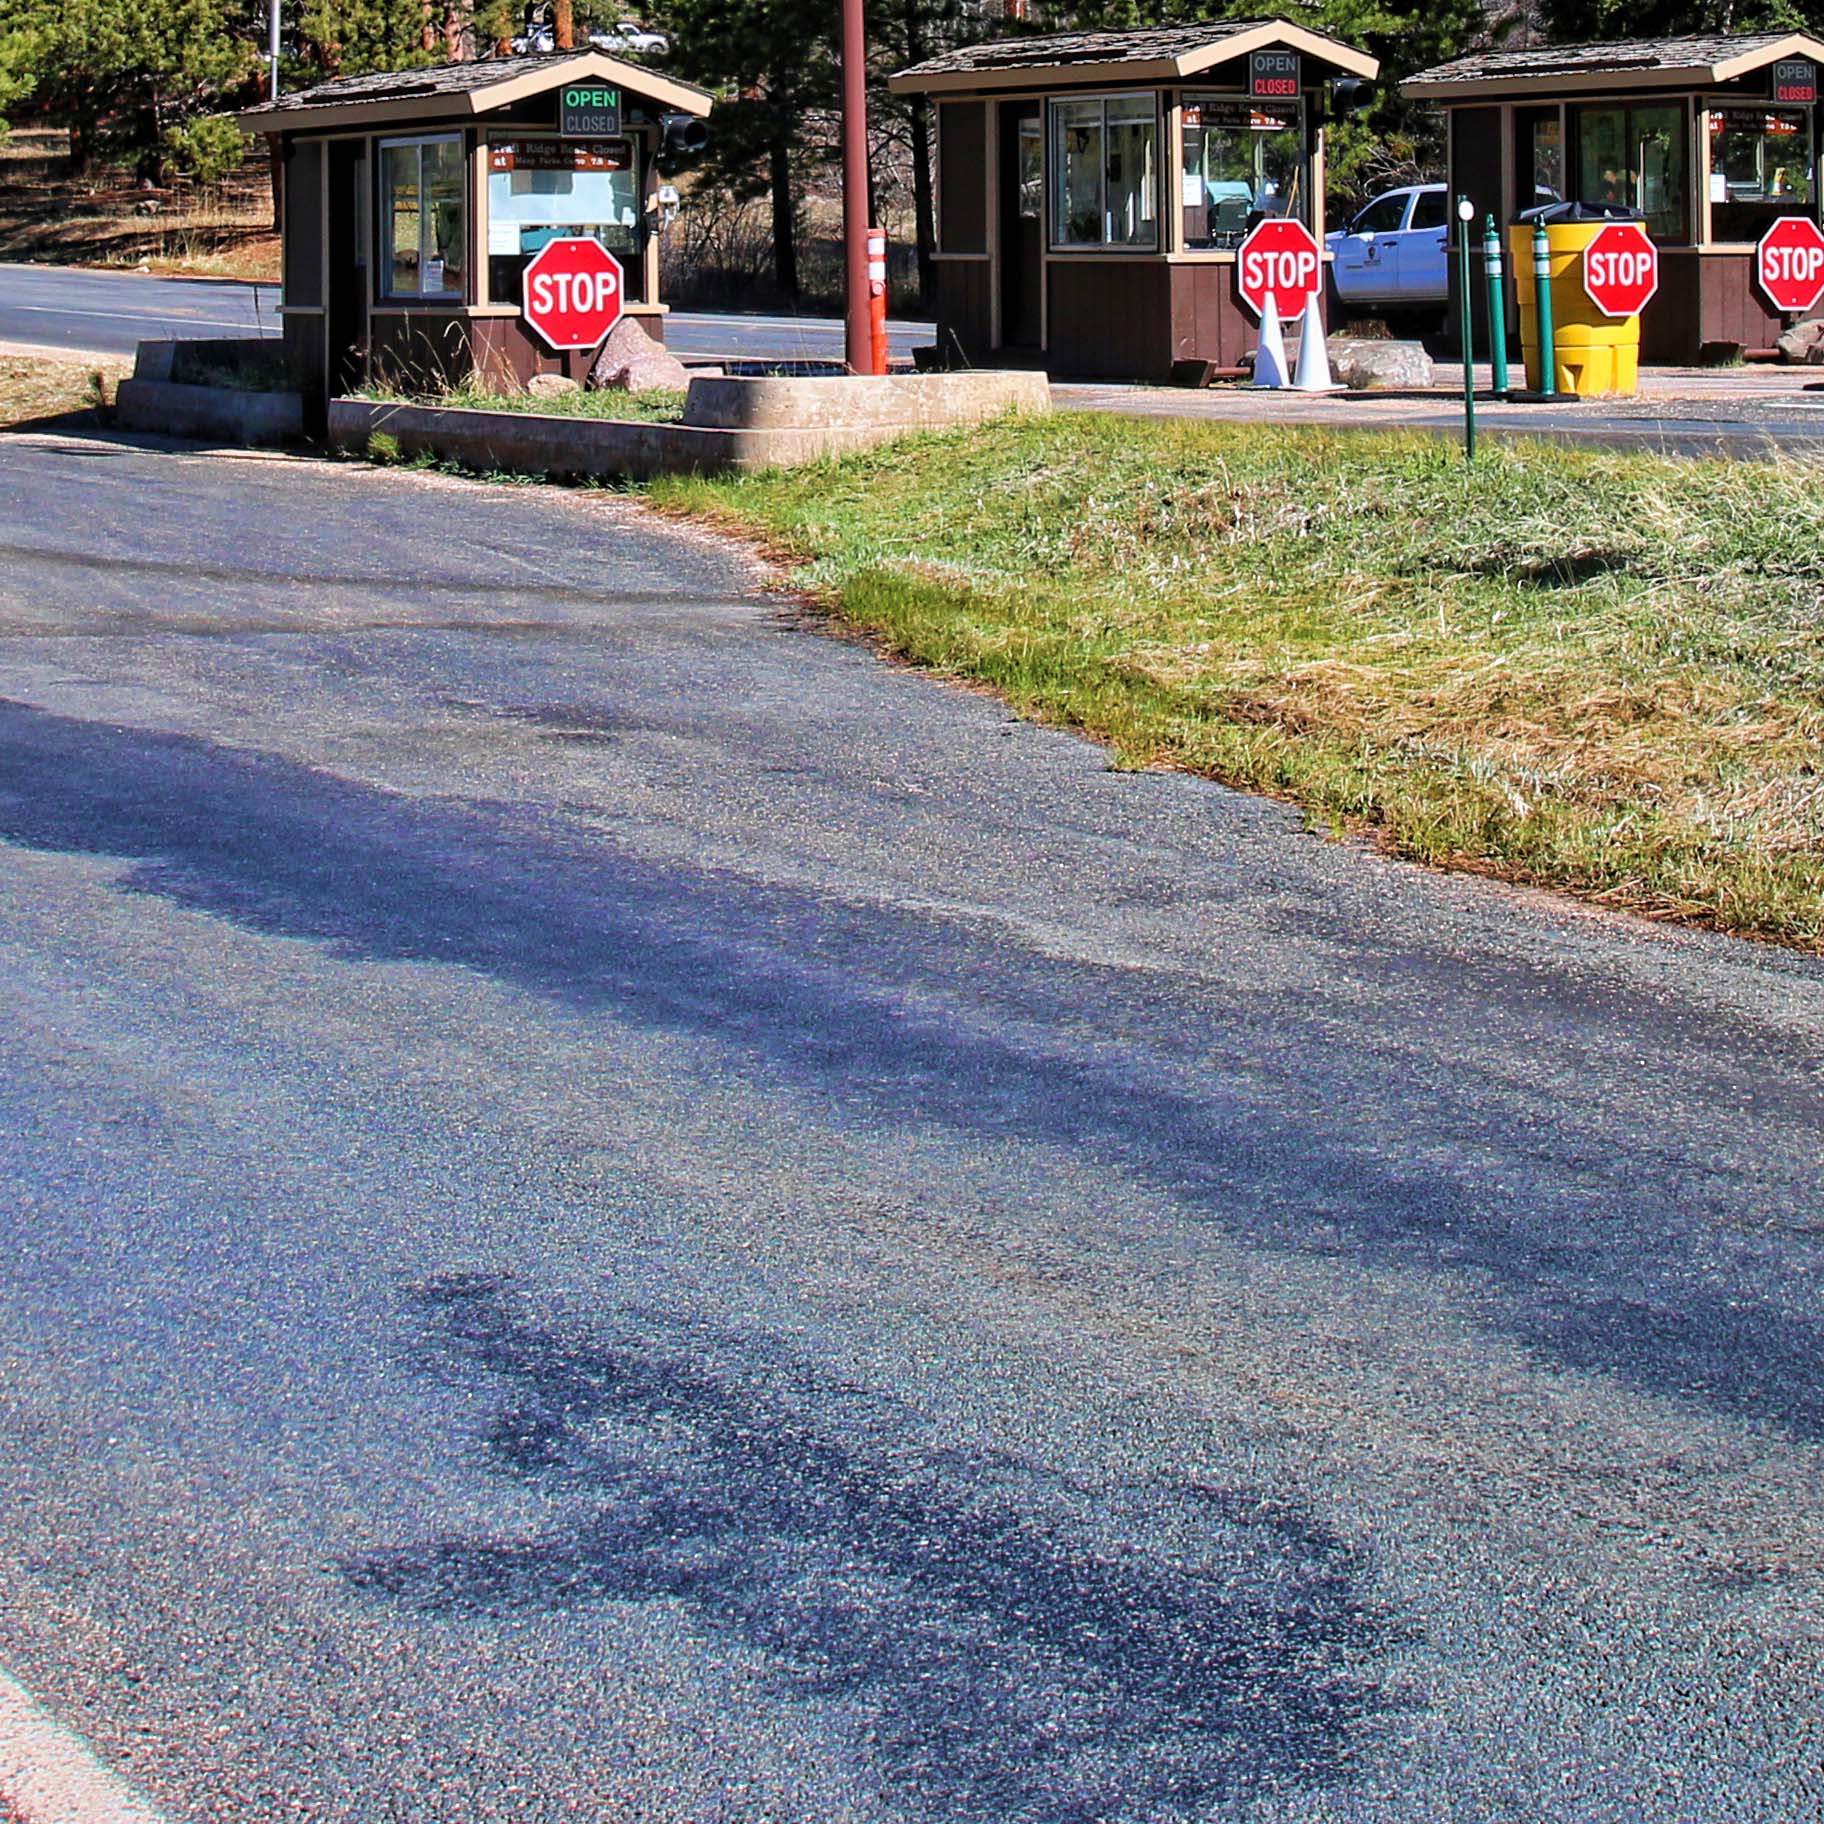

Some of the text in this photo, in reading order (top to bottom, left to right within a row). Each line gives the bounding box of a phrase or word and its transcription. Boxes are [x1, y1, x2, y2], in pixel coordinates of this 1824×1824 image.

[1255, 56, 1296, 71] OPEN
[1777, 65, 1812, 79] OPEN
[1255, 79, 1296, 94] CLOSED
[1778, 86, 1813, 100] CLOSED
[566, 90, 616, 107] OPEN
[566, 116, 615, 132] CLOSED
[494, 156, 507, 166] at
[1245, 251, 1316, 289] STOP
[1589, 252, 1652, 286] STOP
[1764, 247, 1824, 281] STOP
[532, 272, 617, 315] STOP
